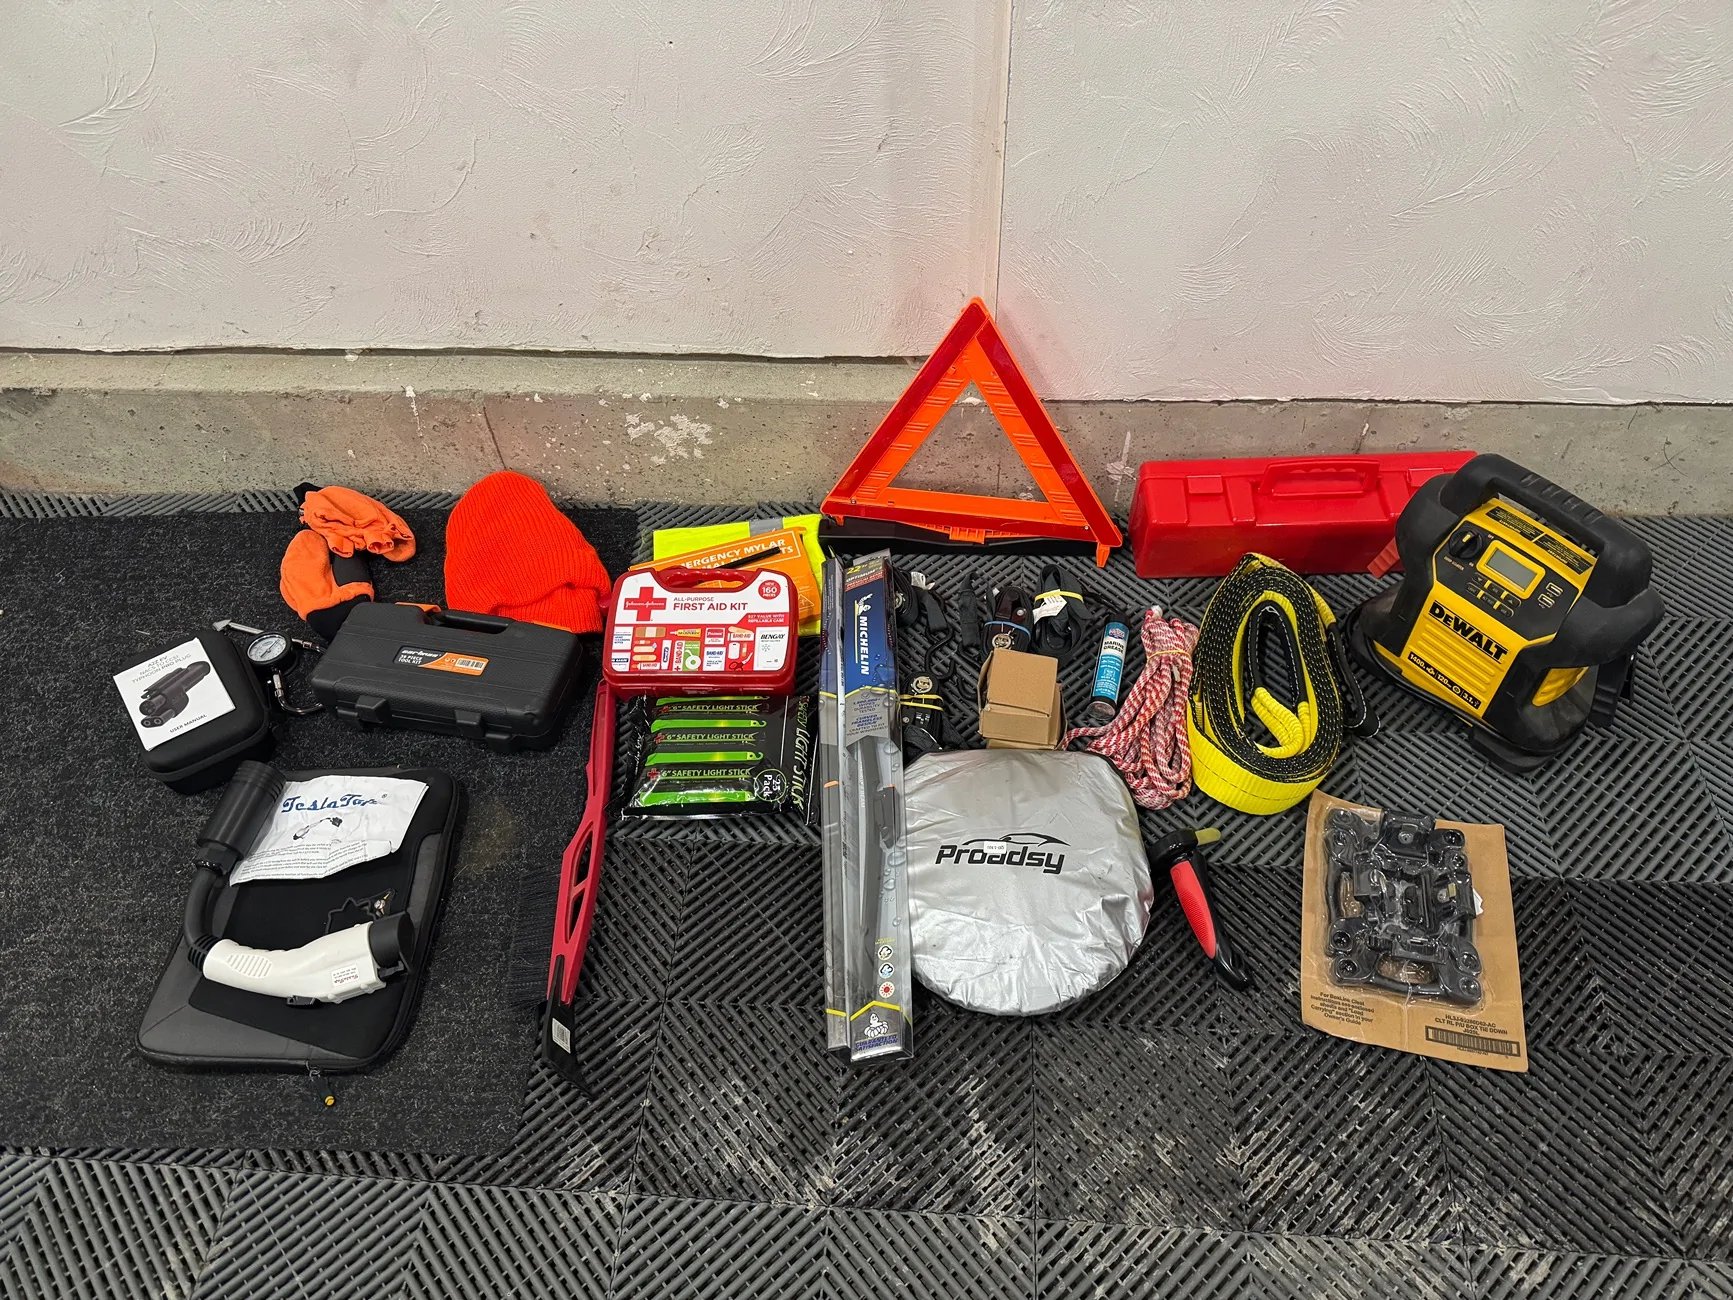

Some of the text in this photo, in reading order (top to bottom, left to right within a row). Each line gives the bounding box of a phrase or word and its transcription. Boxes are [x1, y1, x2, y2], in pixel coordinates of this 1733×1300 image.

[681, 549, 741, 568] ERGENCY
[744, 539, 785, 554] MYLAR
[673, 602, 748, 611] FIRST AID KIT
[859, 616, 870, 675] MICHELIN
[1103, 645, 1124, 654] GREASE
[1104, 641, 1125, 650] MARINE
[169, 714, 207, 733] USER MANUAL
[794, 728, 810, 769] LIGHT
[762, 774, 772, 797] Pack
[772, 779, 781, 791] 25
[791, 765, 806, 810] STICK
[935, 844, 1065, 874] Proadsy
[1311, 995, 1341, 1005] Instructions
[1324, 1012, 1361, 1025] Owner's Guide
[1489, 1027, 1508, 1035] DOWN
